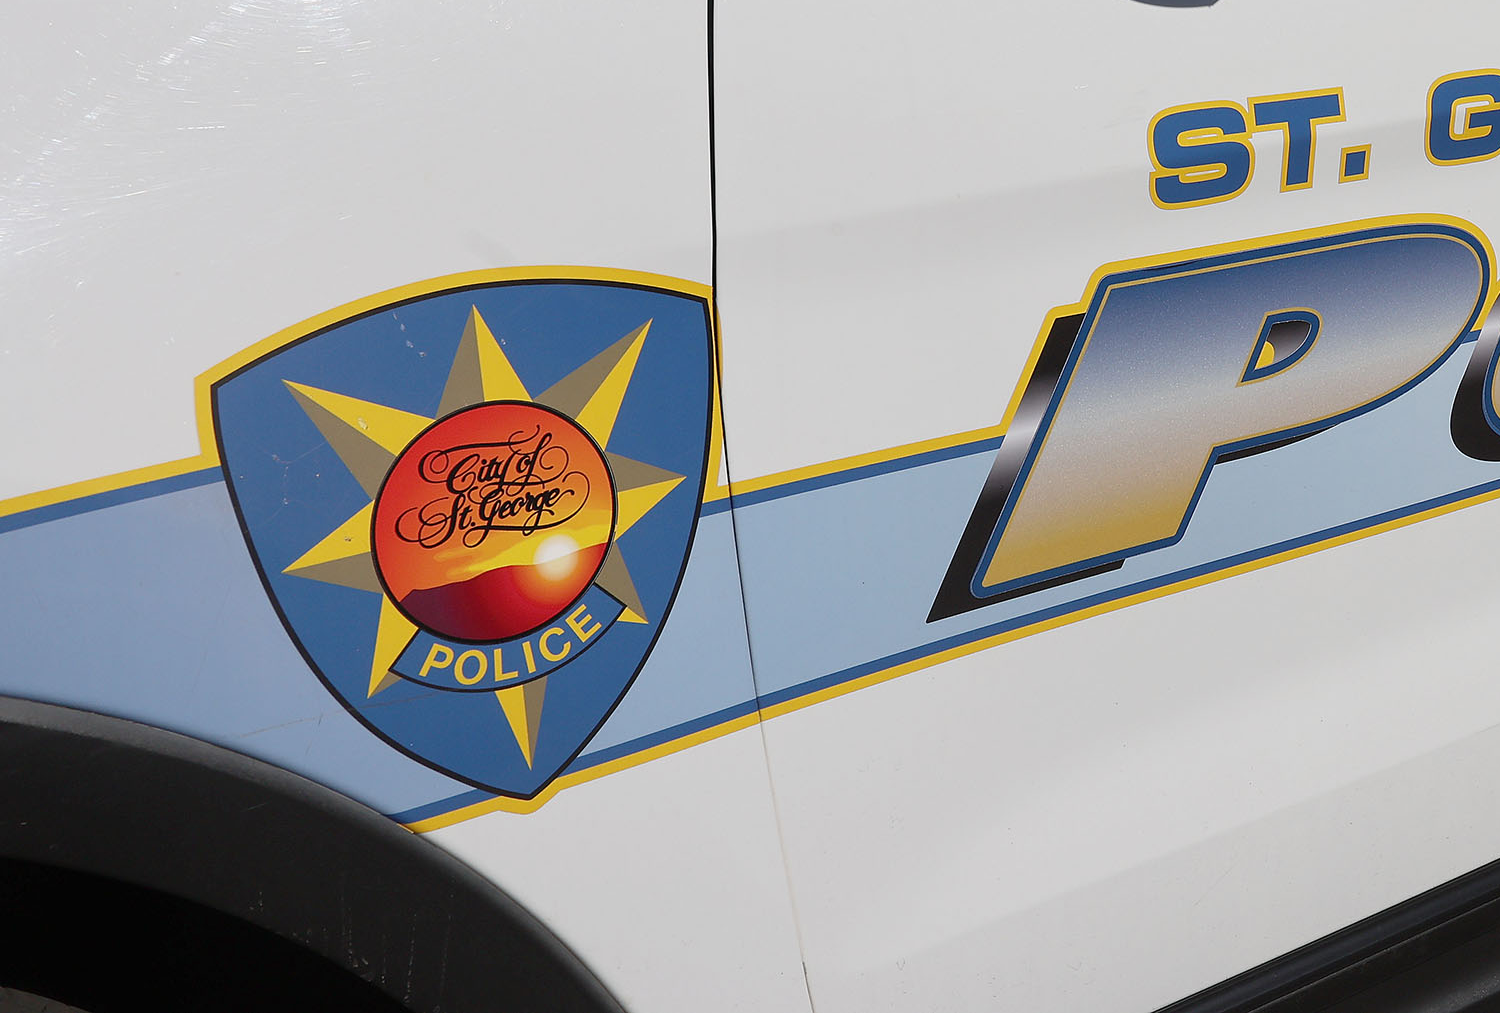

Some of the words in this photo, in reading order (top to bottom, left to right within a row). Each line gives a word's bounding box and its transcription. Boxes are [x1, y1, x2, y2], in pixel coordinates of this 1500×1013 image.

[1149, 87, 1373, 211] ST.
[420, 440, 524, 495] City
[398, 492, 477, 548] St.
[466, 485, 574, 546] George
[418, 603, 602, 685] POLICE
